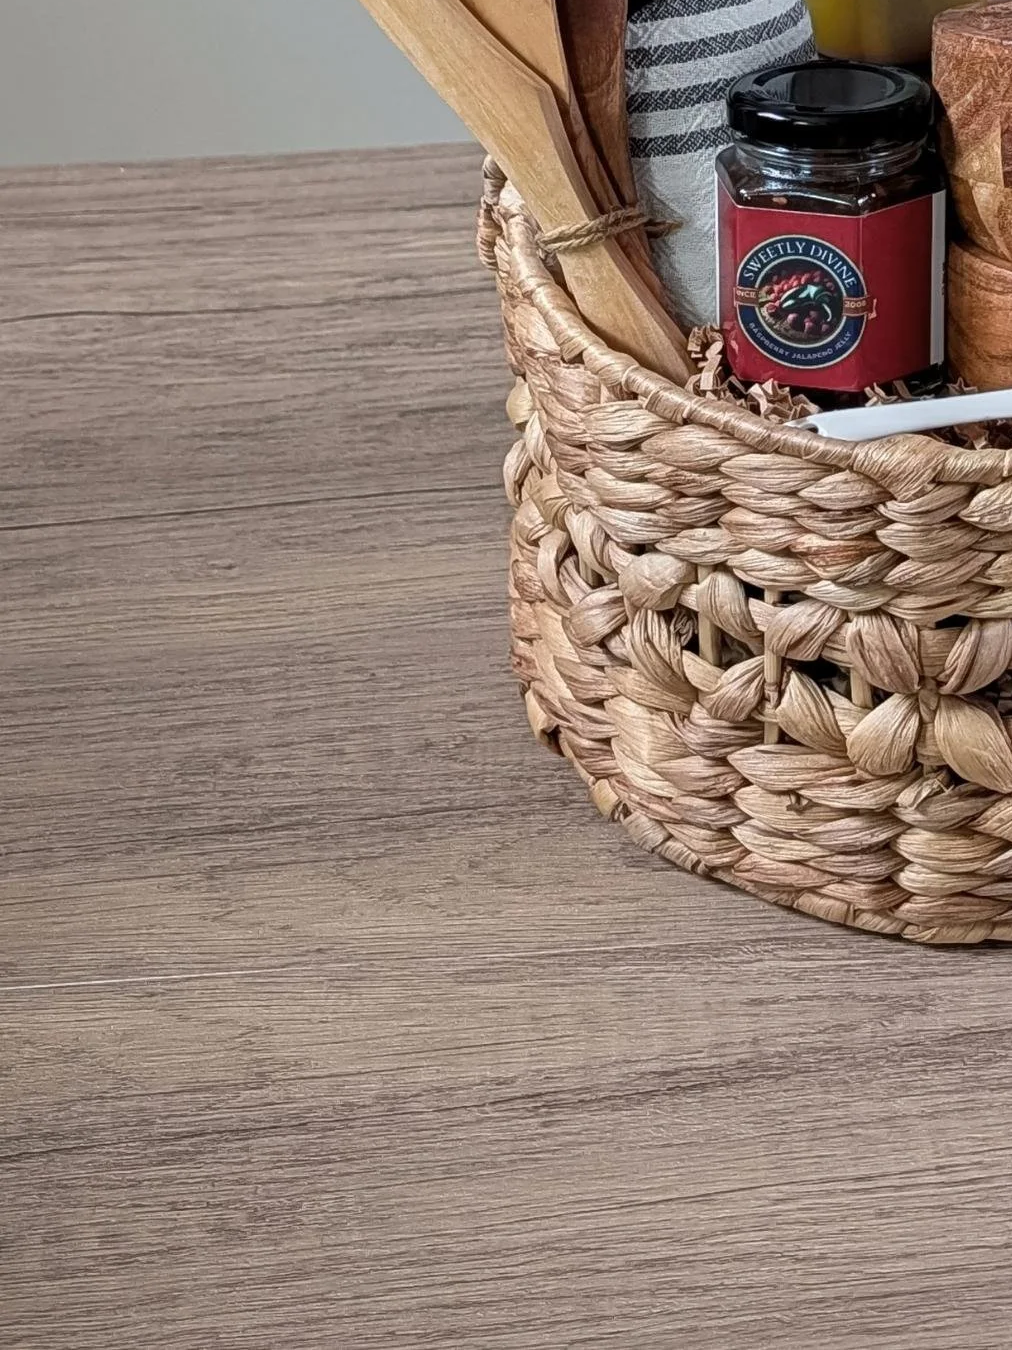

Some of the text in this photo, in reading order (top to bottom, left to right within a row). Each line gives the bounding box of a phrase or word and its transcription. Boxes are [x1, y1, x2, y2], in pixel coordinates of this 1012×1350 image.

[743, 240, 857, 288] SWEETLY DIVINE
[748, 322, 790, 357] RASPBERRY
[834, 331, 852, 350] JELLY
